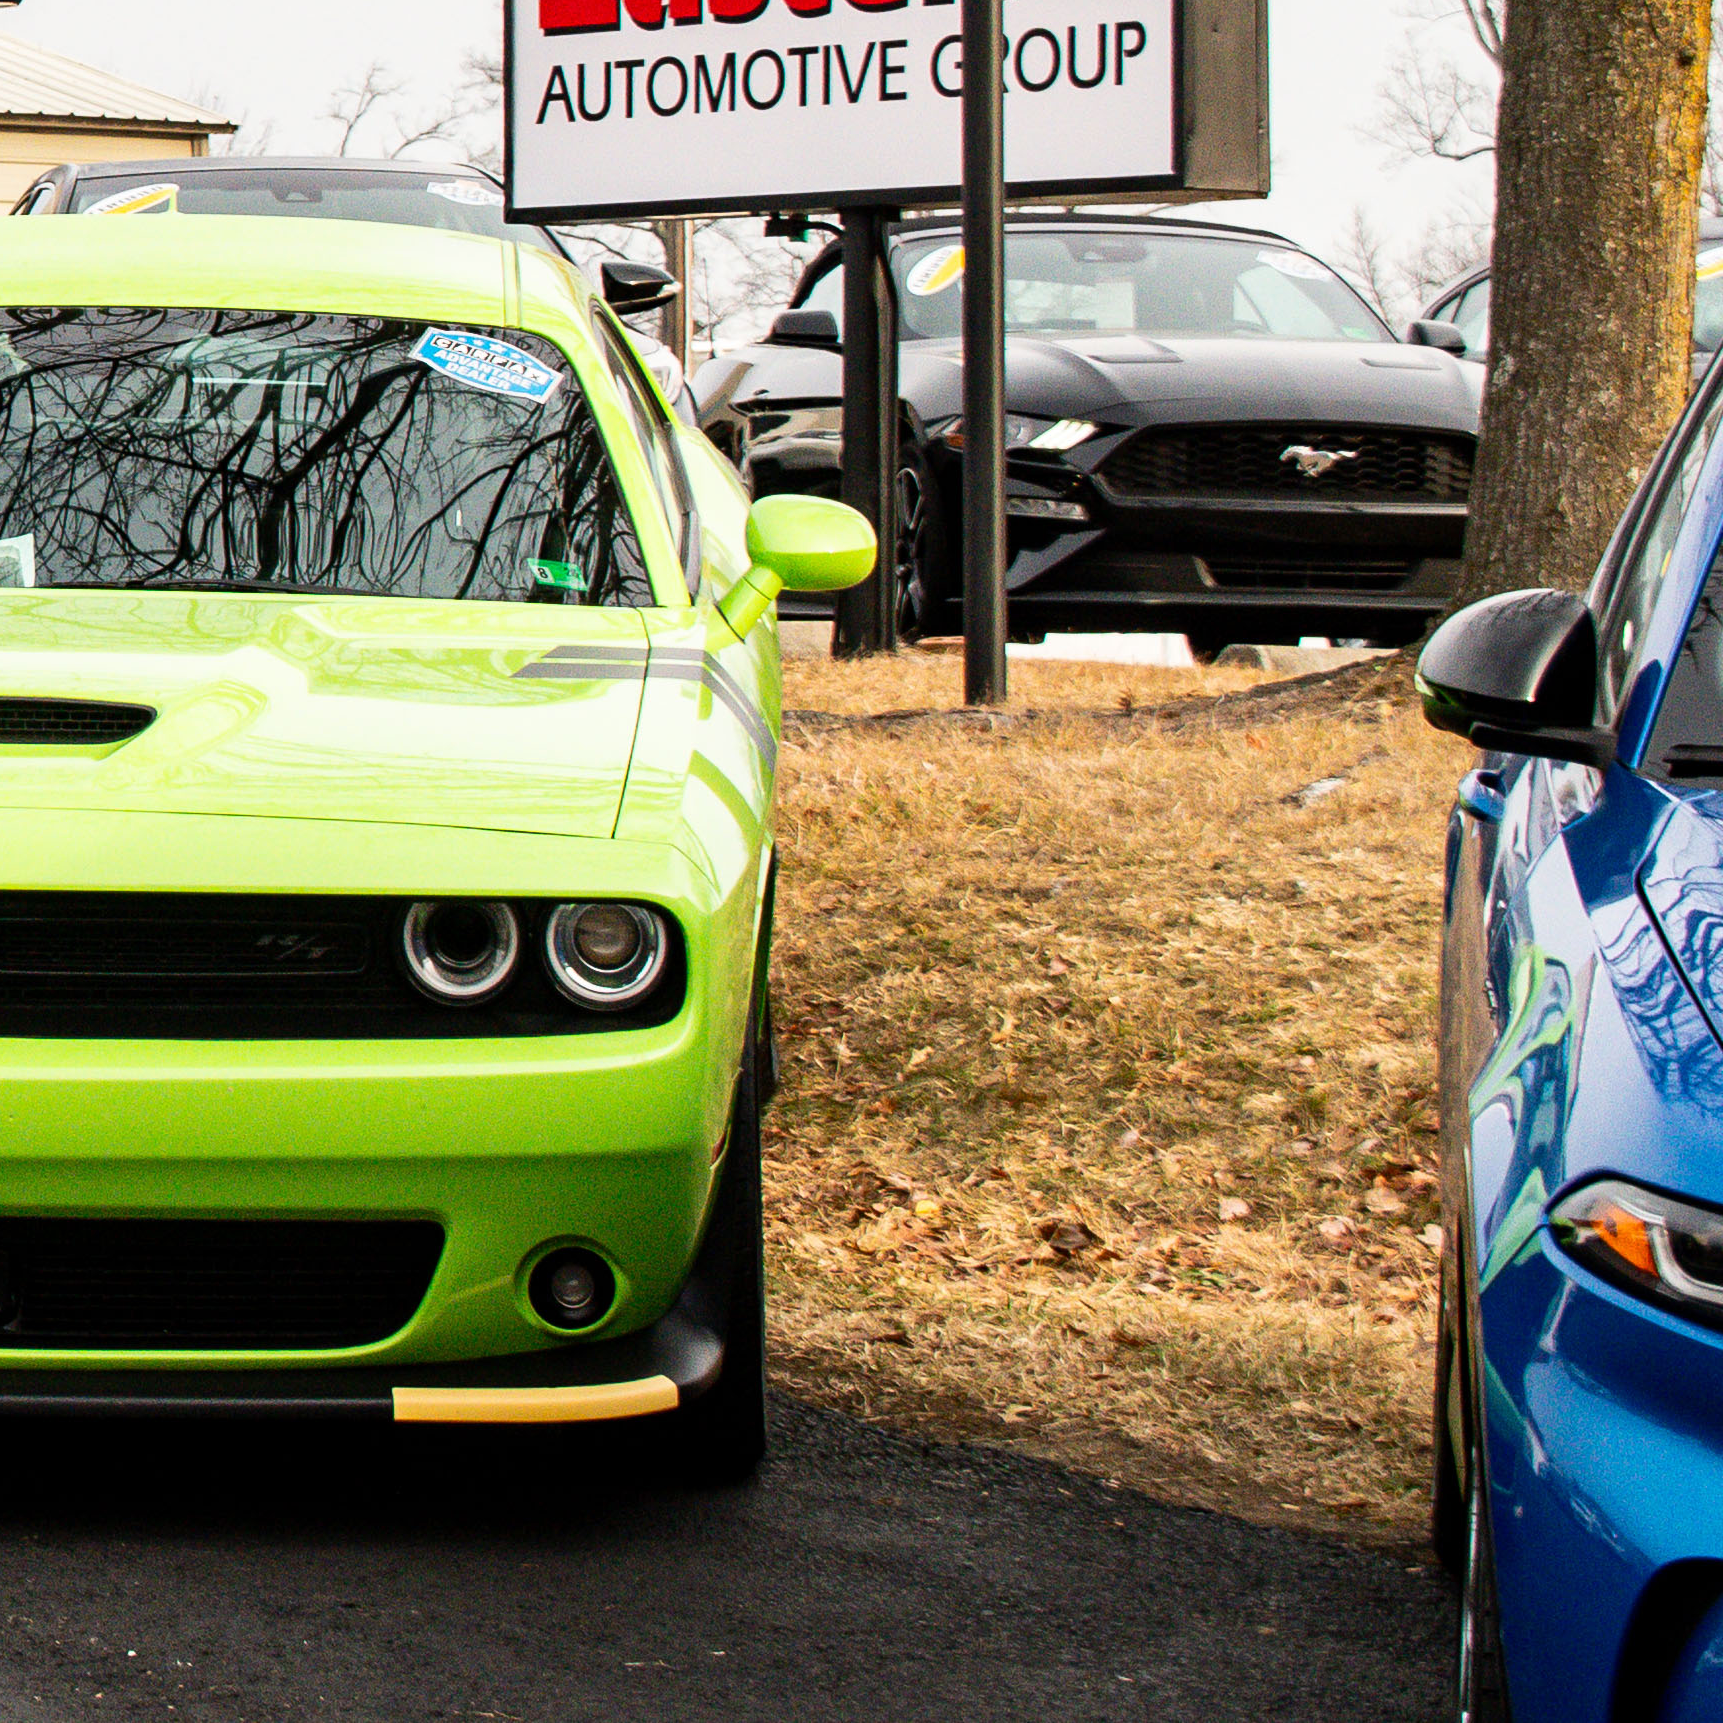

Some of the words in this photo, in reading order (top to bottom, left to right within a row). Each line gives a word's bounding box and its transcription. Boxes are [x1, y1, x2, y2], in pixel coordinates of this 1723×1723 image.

[536, 41, 908, 124] AUTOMOTIVE
[931, 21, 1147, 98] GOUP
[432, 336, 549, 385] CARFAX
[433, 349, 533, 389] ADVANTAGE
[444, 361, 511, 390] DEALER
[537, 567, 549, 579] 8
